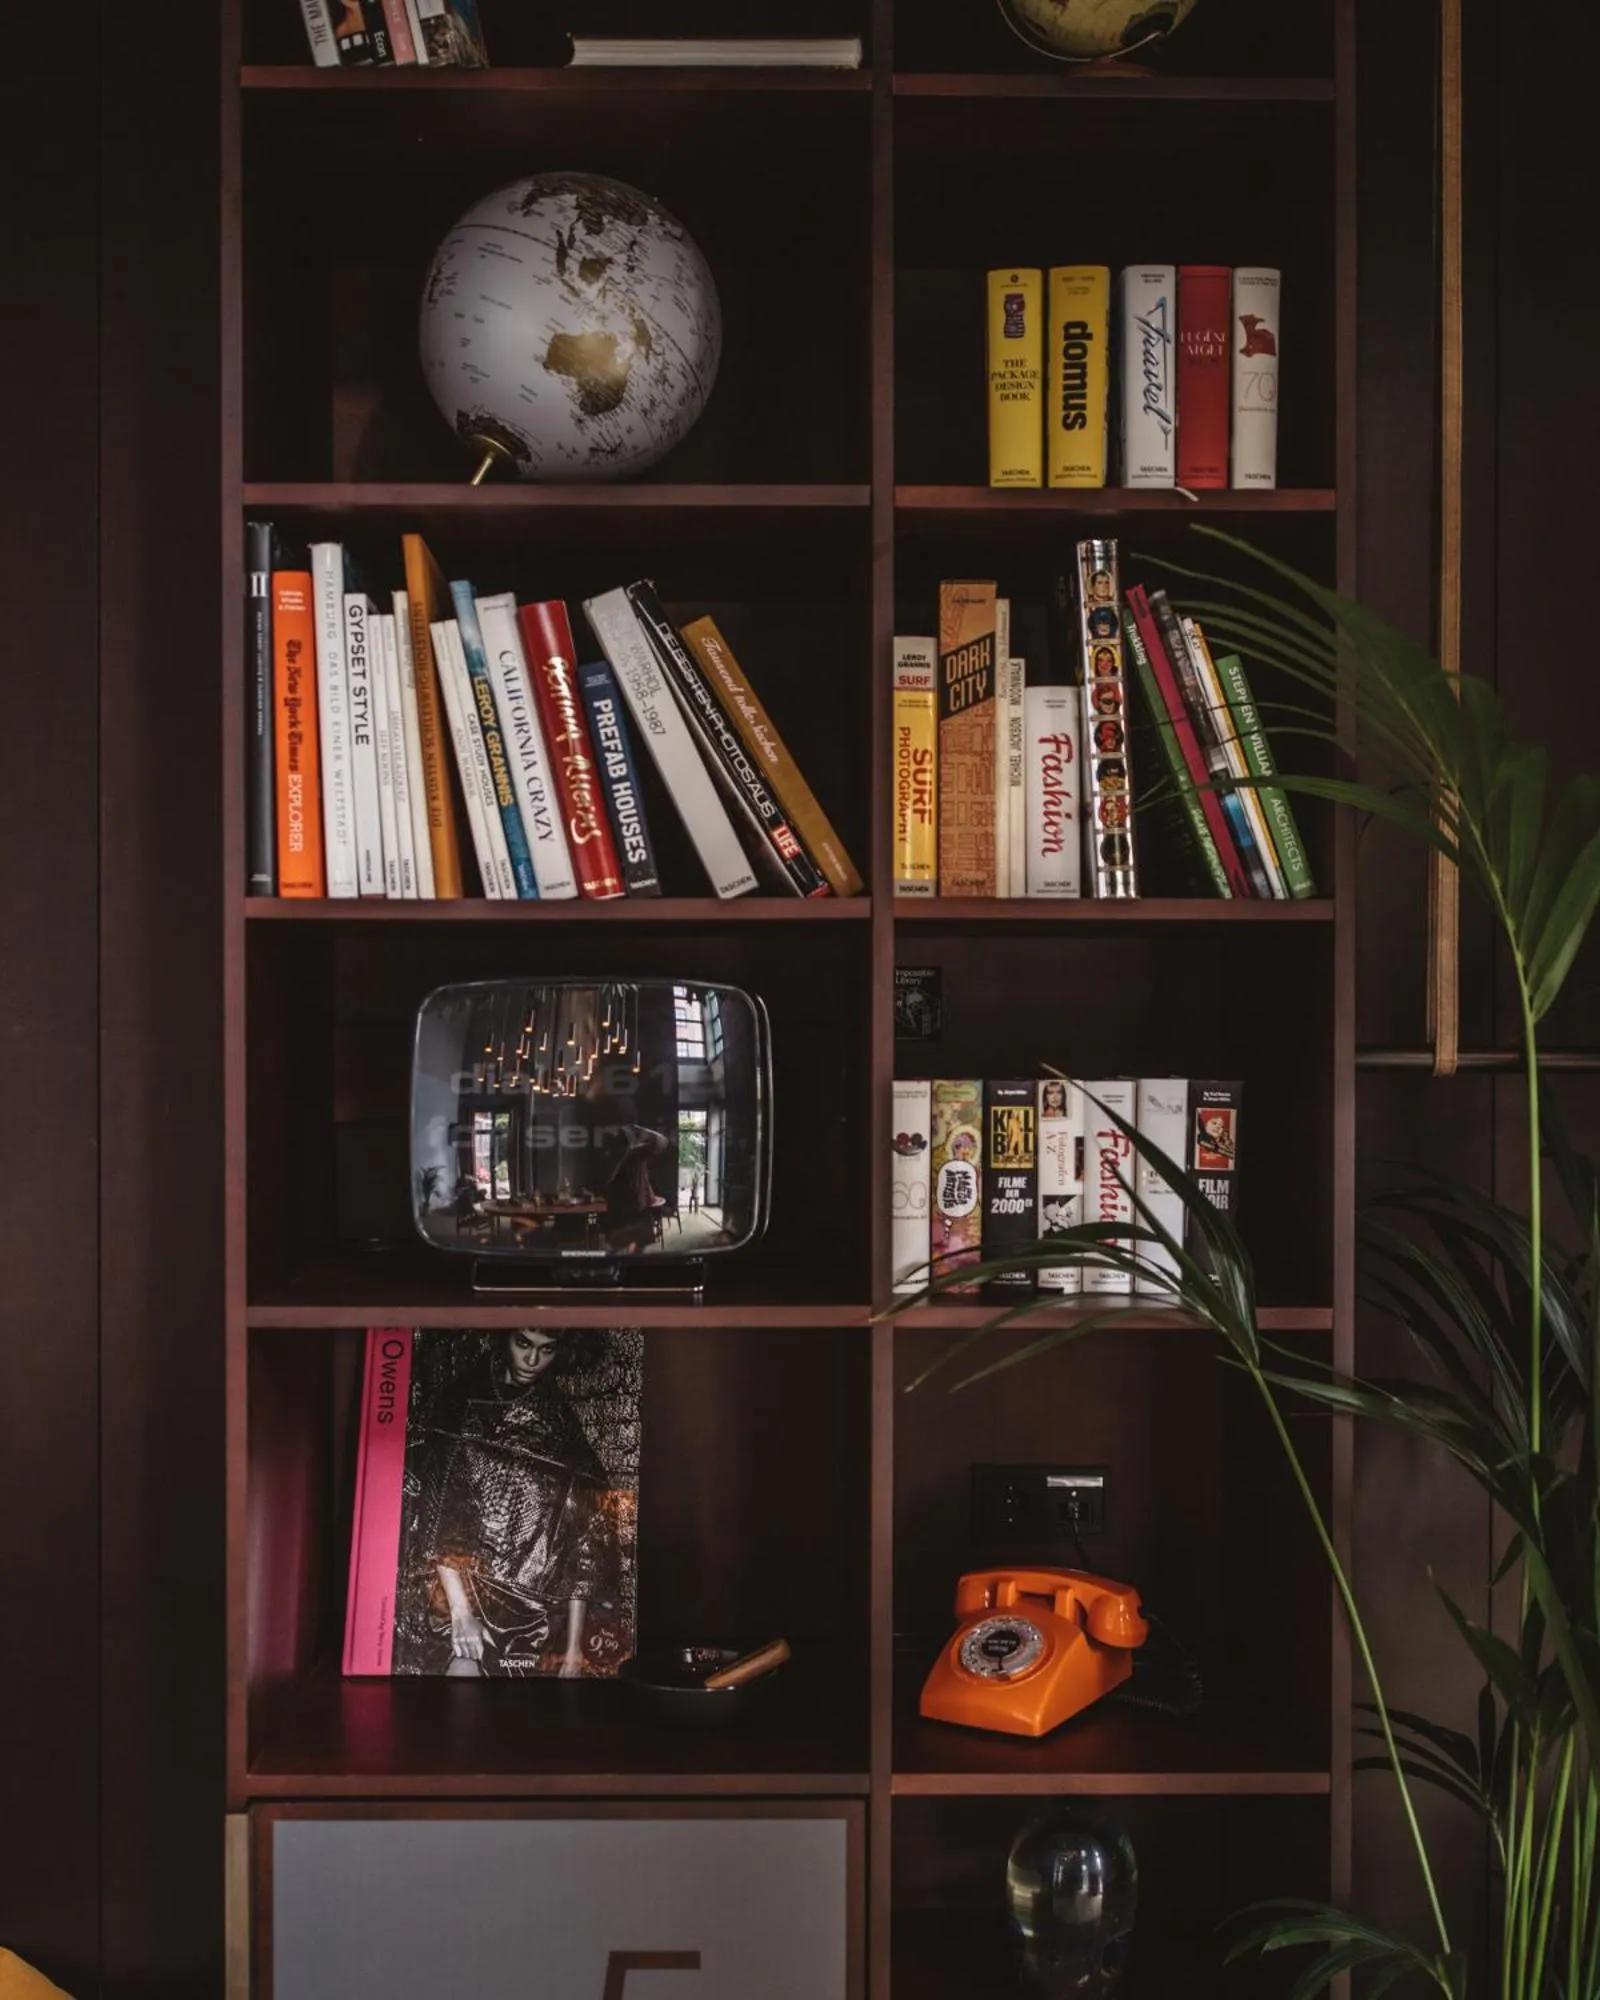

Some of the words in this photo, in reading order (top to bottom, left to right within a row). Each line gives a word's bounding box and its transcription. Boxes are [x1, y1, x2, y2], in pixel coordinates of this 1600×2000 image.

[991, 371, 1040, 380] PACKAGE
[1003, 359, 1025, 368] THE
[1062, 321, 1093, 431] domus
[995, 382, 1036, 391] DESIGN
[1000, 393, 1031, 401] BOOK
[325, 570, 337, 639] HAMBURG
[286, 640, 302, 665] The
[348, 605, 365, 680] GYPSET
[329, 652, 339, 677] DAS
[946, 637, 991, 685] DARK
[287, 666, 302, 694] New
[899, 675, 931, 685] SURF
[950, 670, 987, 713] CITY
[284, 697, 302, 730] York
[330, 684, 341, 714] BILD
[353, 687, 369, 746] STYLE
[474, 676, 499, 728] LEROY
[467, 713, 480, 737] CASE
[287, 730, 303, 772] Times
[472, 738, 487, 767] STUDY
[499, 650, 537, 768] CALIFORNIA
[526, 778, 554, 842] CRAZY
[486, 731, 514, 807] GRANNIS
[593, 699, 626, 777] PREFAB
[612, 783, 647, 864] HOUSES
[478, 769, 494, 807] HOUSES
[912, 749, 933, 825] SURF
[1038, 732, 1074, 858] Fashion
[288, 774, 303, 852] EXPLORER
[334, 768, 347, 845] WELTSTADT
[772, 825, 802, 860] LIFE
[1271, 798, 1304, 873] ARCHITECTS
[899, 885, 929, 893] TASCHEN
[998, 1176, 1028, 1189] FILME
[1004, 1189, 1020, 1198] DER
[1198, 1178, 1230, 1194] FILM
[1205, 1194, 1229, 1210] OIR
[377, 1340, 404, 1425] Owens
[499, 1659, 536, 1668] TASCHEN
